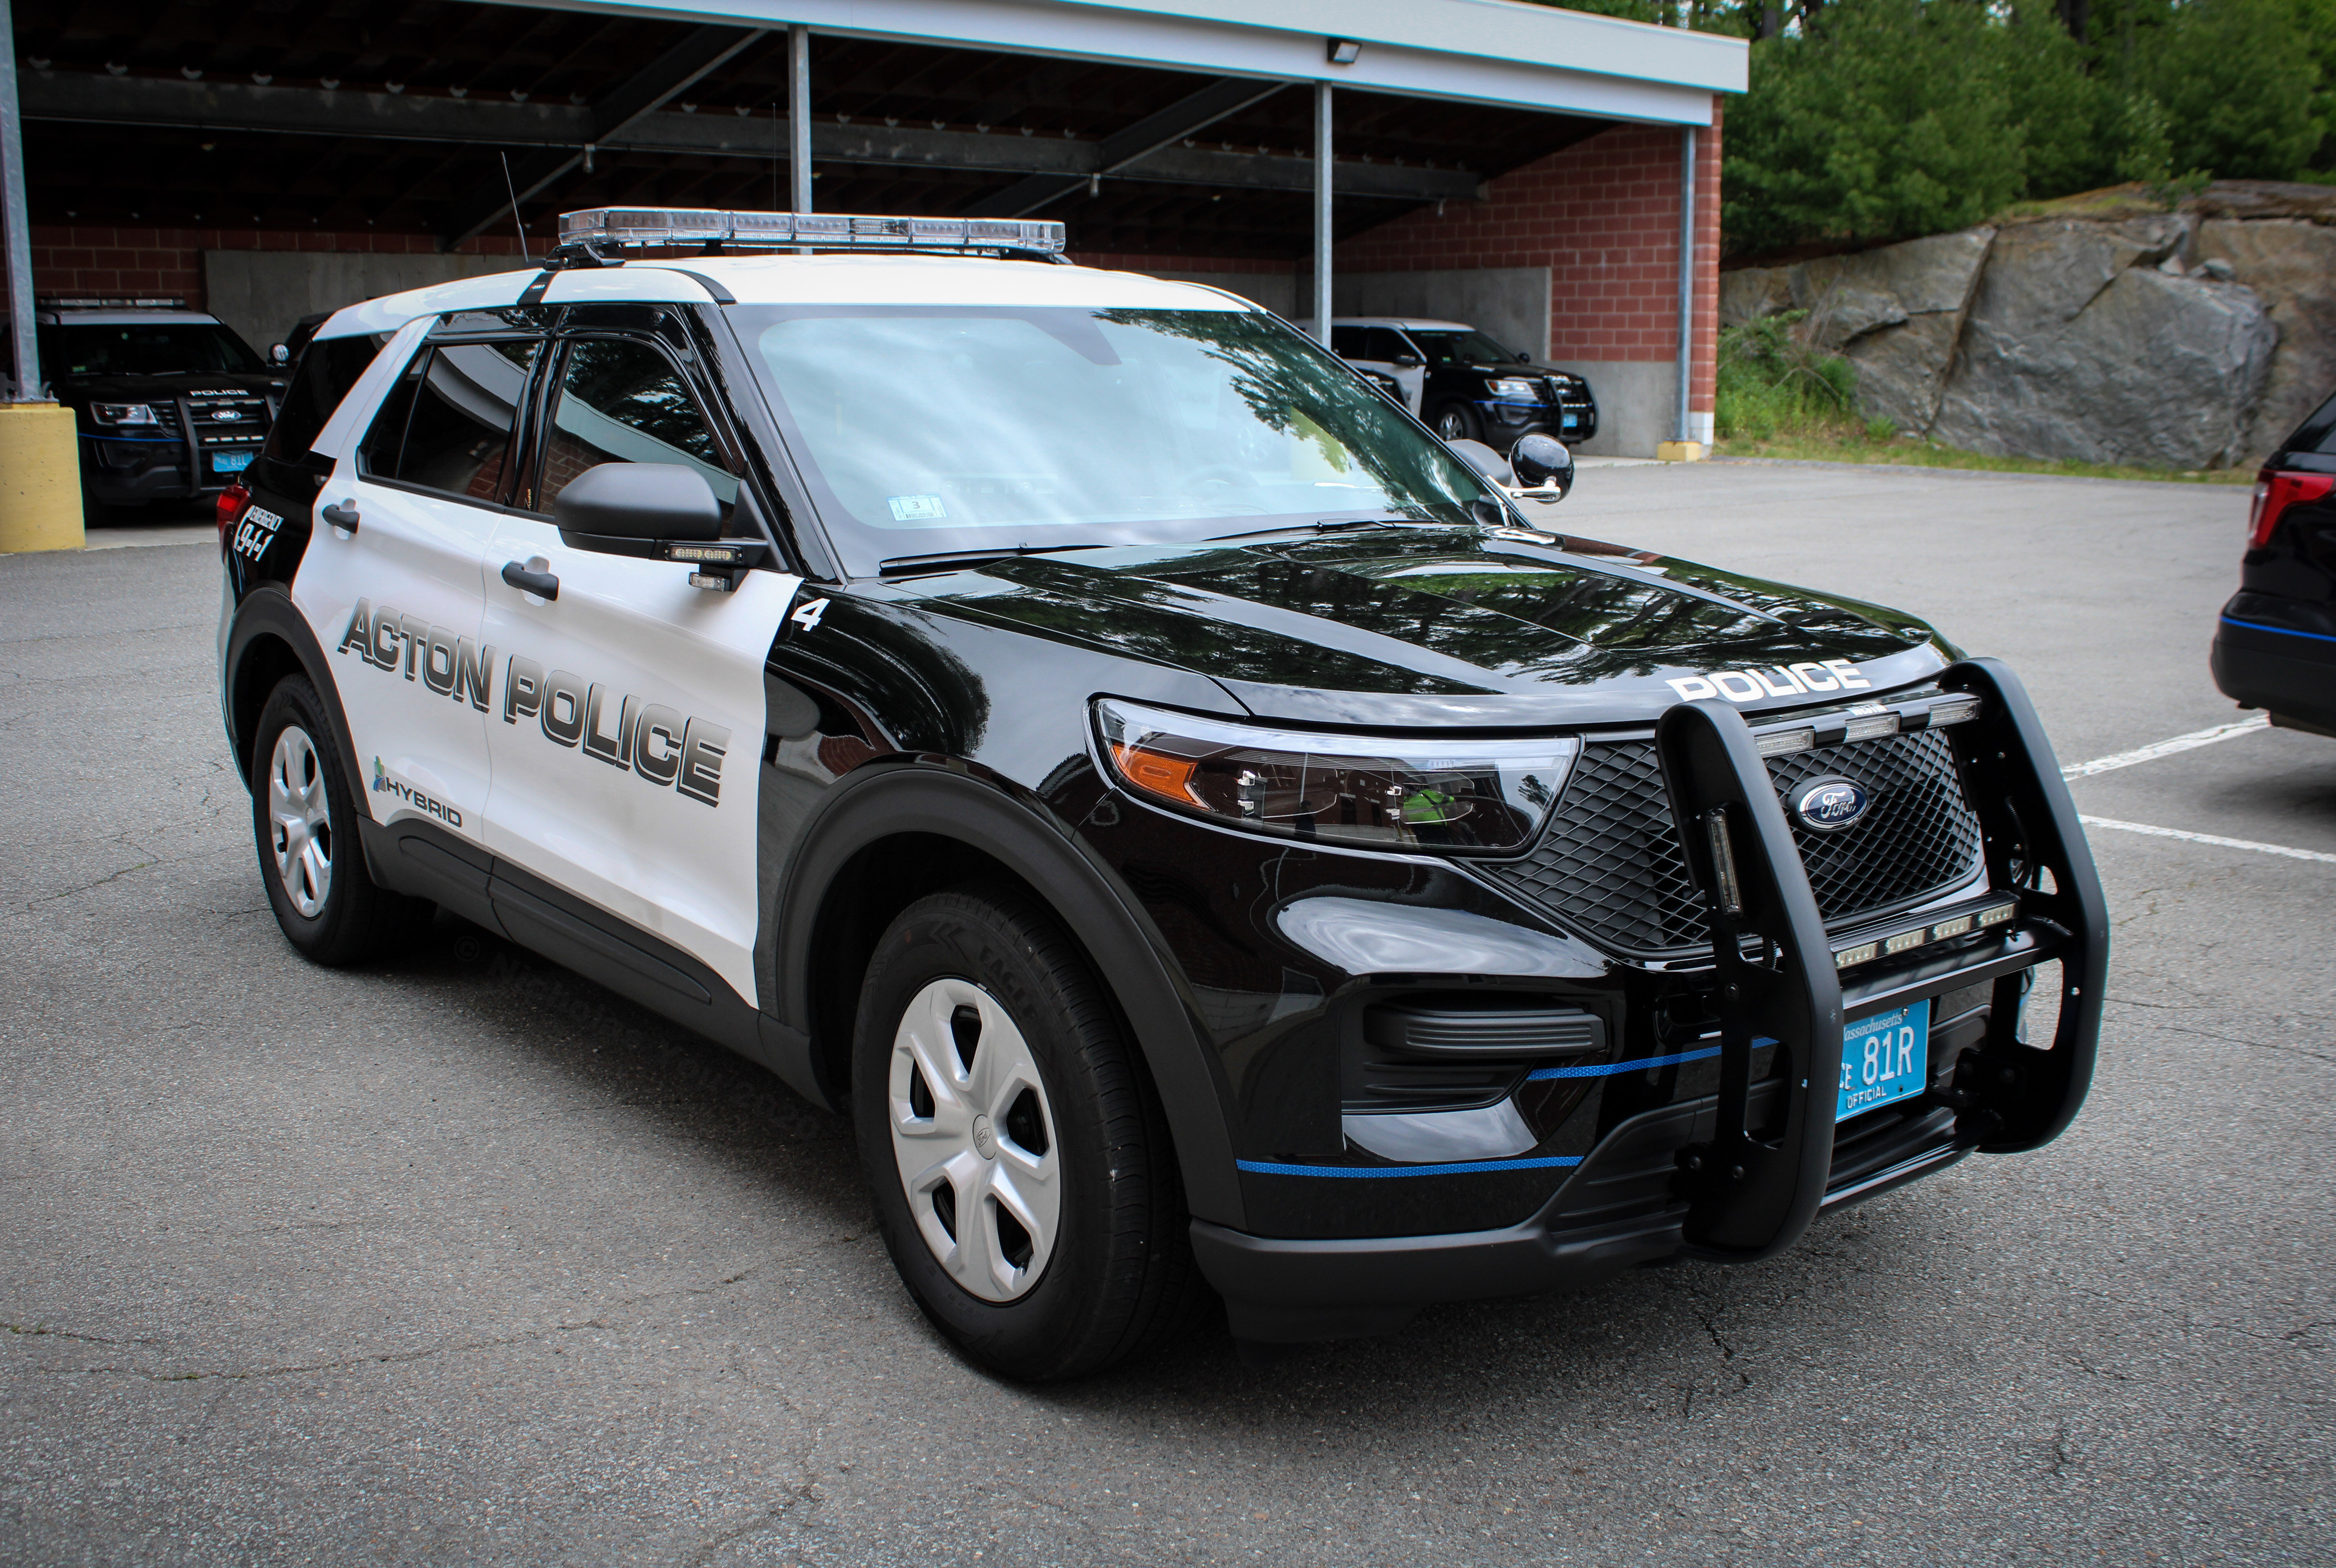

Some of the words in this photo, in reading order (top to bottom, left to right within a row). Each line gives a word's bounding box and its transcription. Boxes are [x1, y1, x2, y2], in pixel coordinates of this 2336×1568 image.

[237, 523, 274, 562] 9-1-1
[790, 598, 831, 632] 4
[1664, 659, 1872, 702] POLICE
[337, 596, 497, 714] ACTON
[504, 653, 732, 808] POLICE
[386, 777, 463, 828] HYBRID
[1820, 791, 1857, 819] Ford
[1843, 1013, 1903, 1041] assachusetts
[1862, 1026, 1915, 1086] 81R
[1846, 1085, 1887, 1109] OFFICIAL
